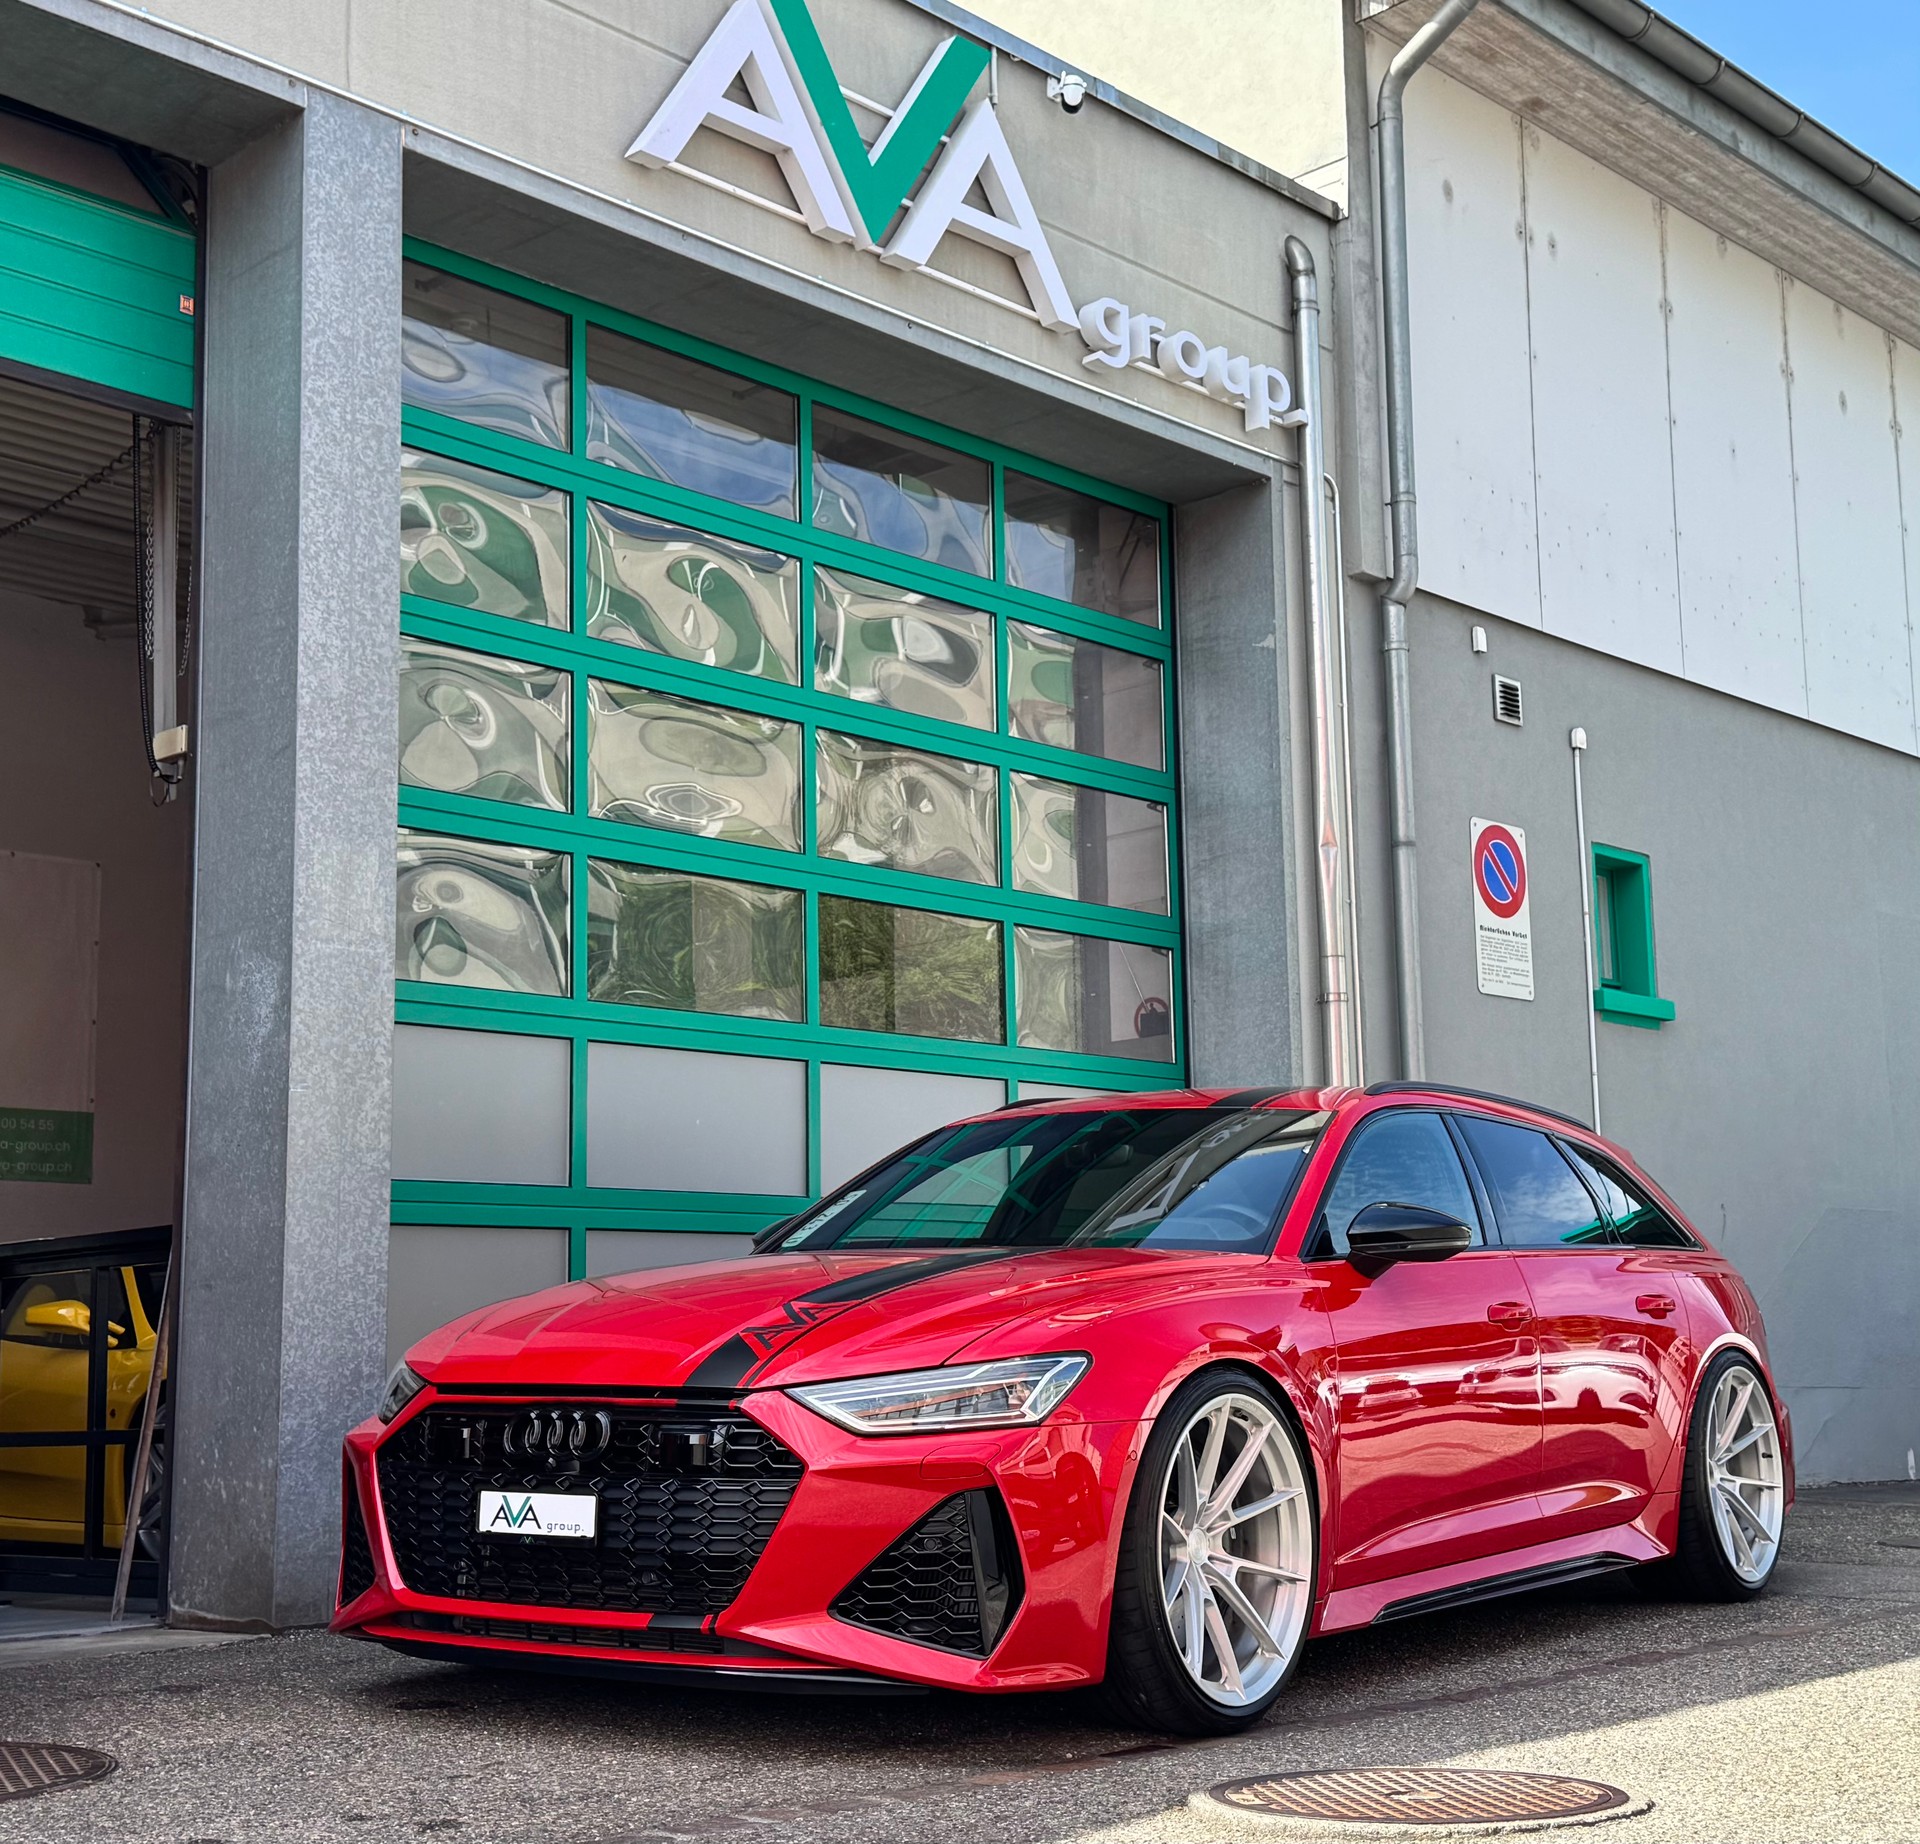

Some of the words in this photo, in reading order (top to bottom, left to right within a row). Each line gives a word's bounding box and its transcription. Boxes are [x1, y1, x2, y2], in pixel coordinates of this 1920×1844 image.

[624, 0, 1081, 335] AVA
[740, 1301, 857, 1350] AVA
[490, 1495, 542, 1529] AVA
[546, 1521, 585, 1534] group.
